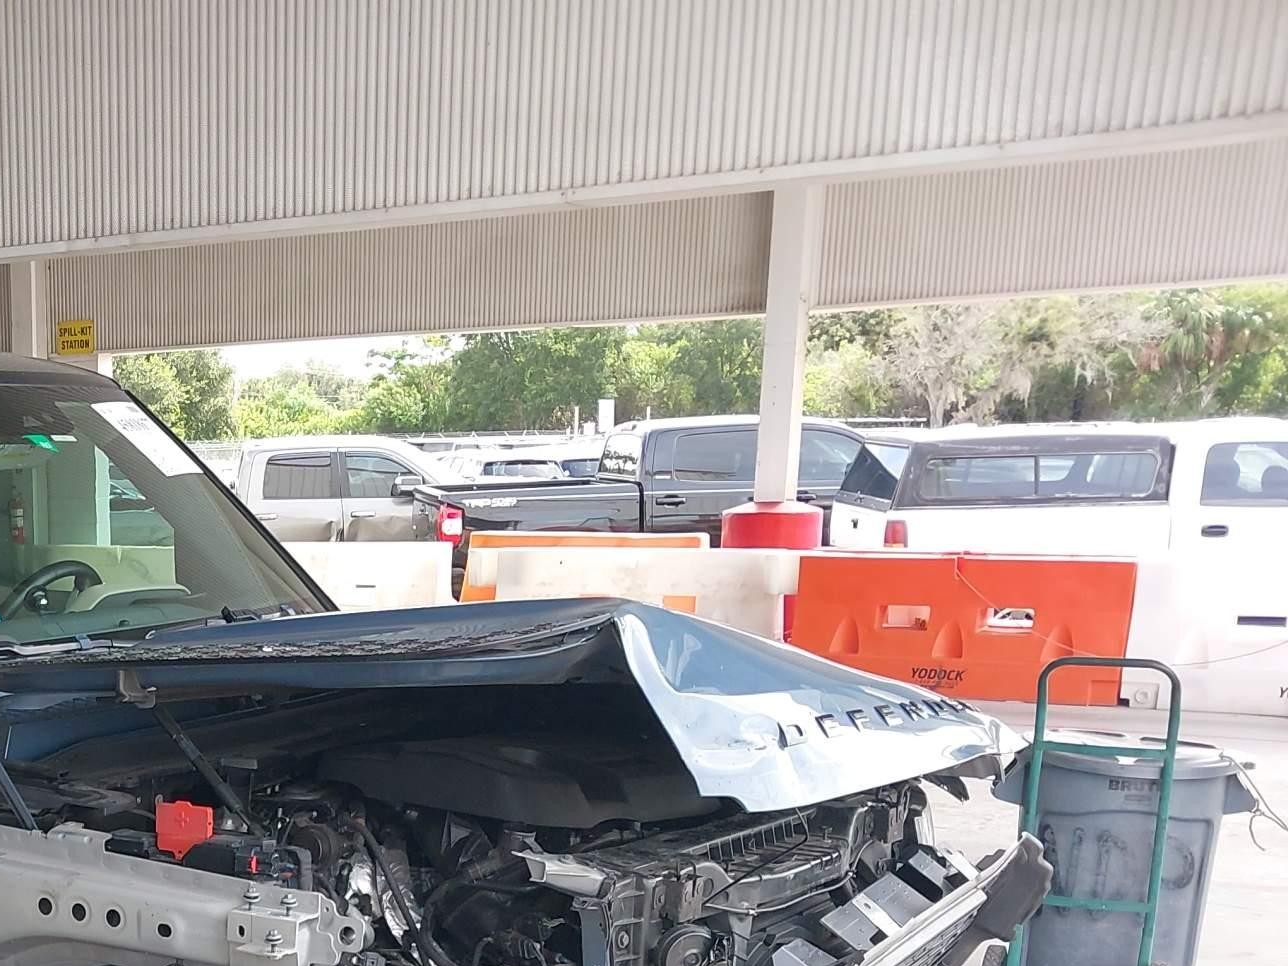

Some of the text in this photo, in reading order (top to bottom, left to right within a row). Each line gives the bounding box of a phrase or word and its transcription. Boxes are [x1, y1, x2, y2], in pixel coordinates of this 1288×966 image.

[59, 326, 92, 337] SPILL-KIT
[61, 339, 90, 350] STATION
[911, 667, 965, 681] YODOCK
[1108, 779, 1161, 791] BRUT
